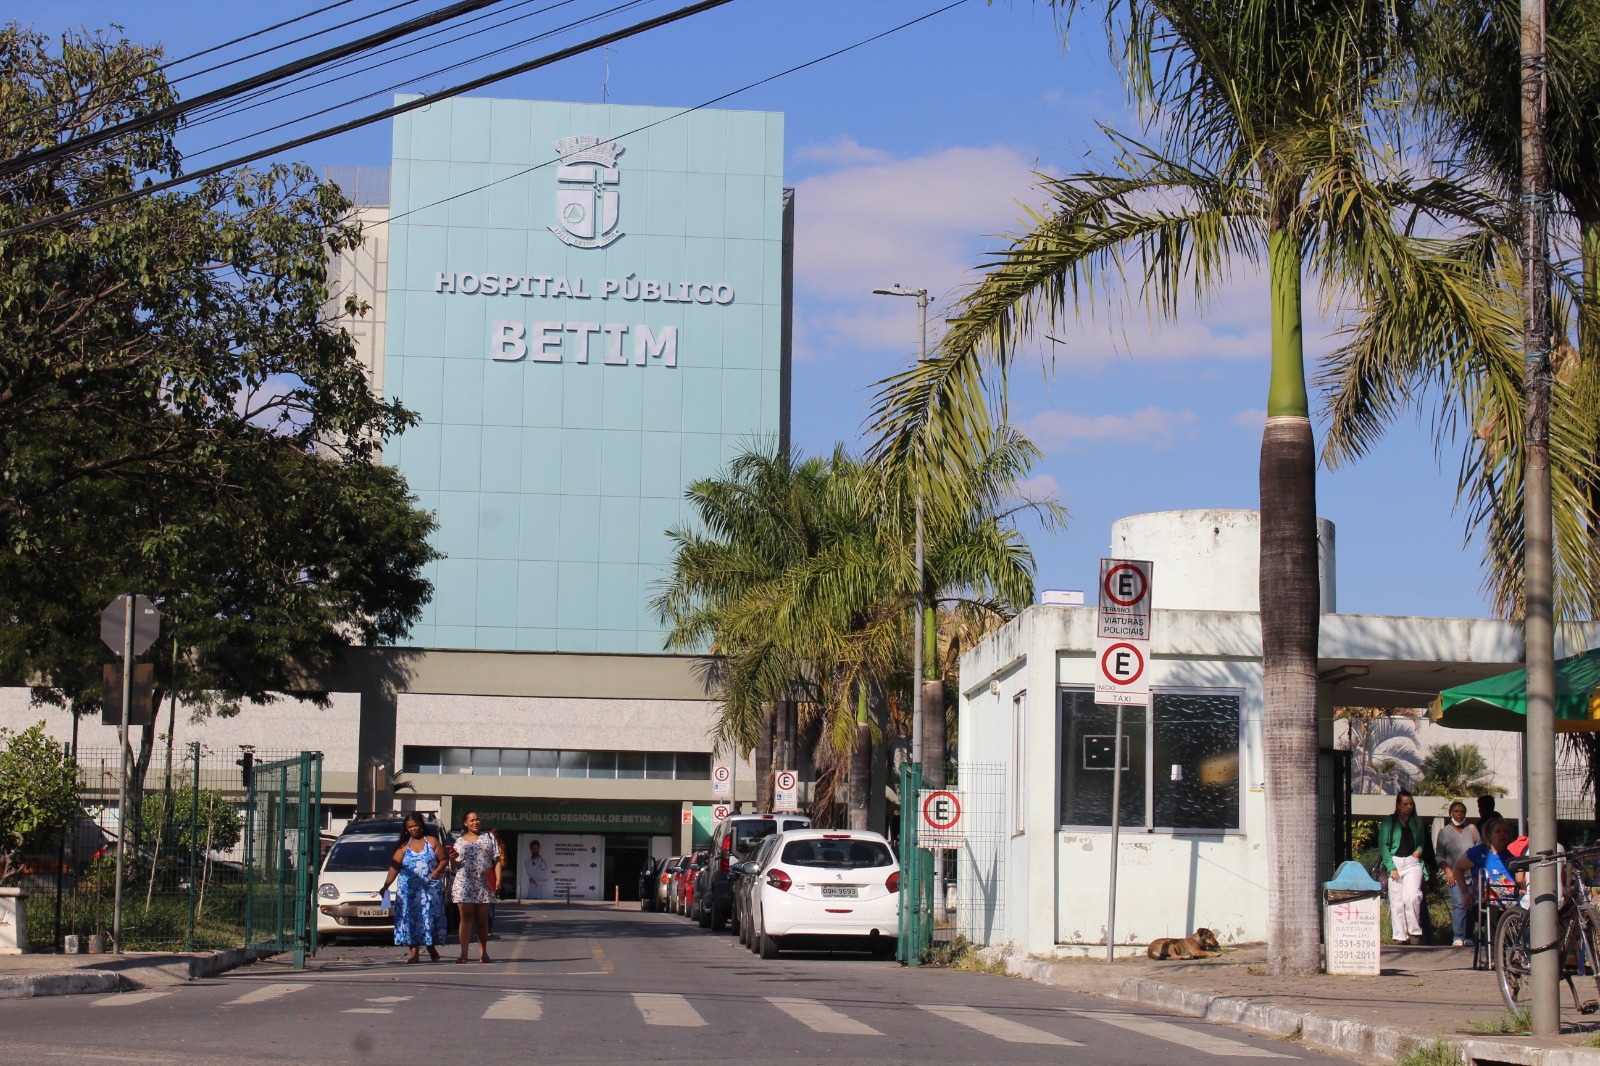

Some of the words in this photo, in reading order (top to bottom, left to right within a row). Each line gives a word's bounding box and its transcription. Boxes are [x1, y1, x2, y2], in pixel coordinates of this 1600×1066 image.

[435, 271, 590, 298] HOSPITAL
[600, 273, 735, 305] PÚBLICO
[491, 318, 679, 369] BETIM
[1118, 573, 1133, 596] E
[1104, 616, 1144, 626] VIATURAS
[1103, 626, 1144, 636] POLICIAIS
[1115, 652, 1131, 675] E
[719, 770, 725, 778] E
[783, 776, 790, 786] E
[936, 801, 948, 820] E
[477, 811, 518, 821] OSPITAL
[519, 810, 559, 822] PÚBLICO
[560, 814, 606, 823] REGIONAL
[608, 814, 621, 823] DE
[622, 814, 651, 824] BETIM
[1334, 939, 1376, 948] 3531-5794
[1334, 951, 1376, 960] 3591-2011
